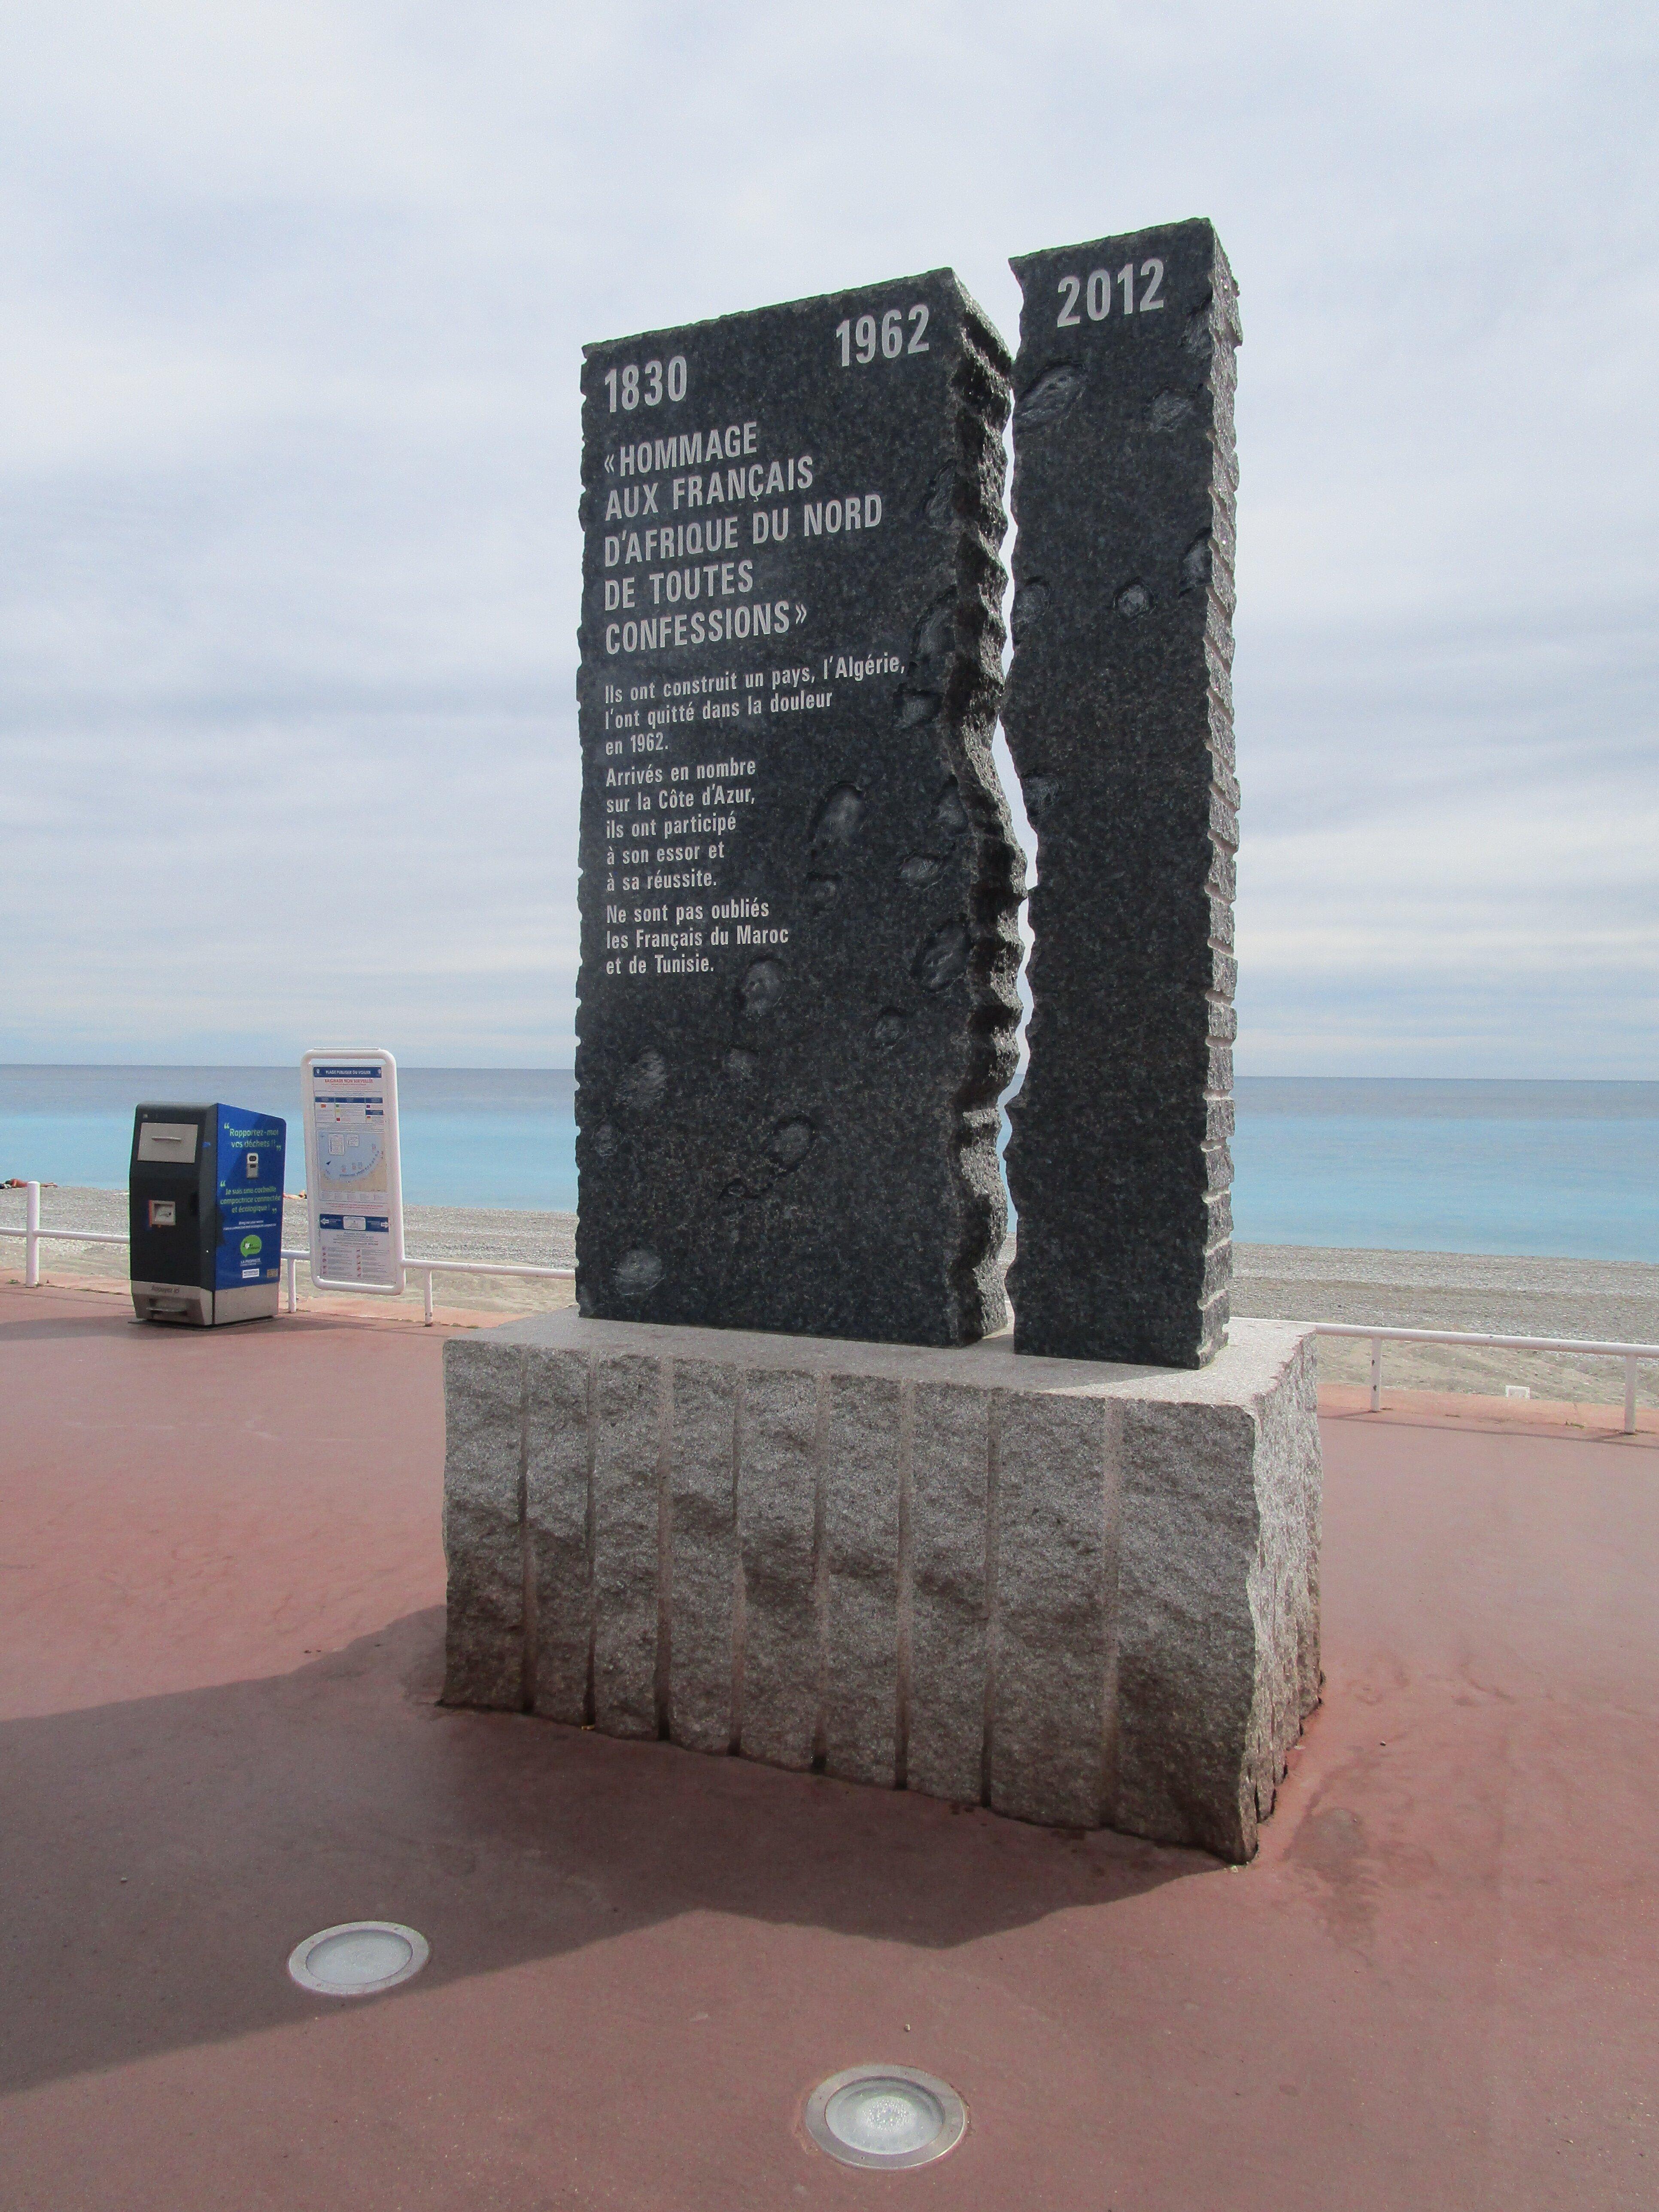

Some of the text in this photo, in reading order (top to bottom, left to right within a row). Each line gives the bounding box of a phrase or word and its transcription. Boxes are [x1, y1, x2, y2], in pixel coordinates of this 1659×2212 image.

[1057, 259, 1164, 327] 2012
[605, 305, 929, 412] 1830 1962
[605, 422, 757, 476] «HOMMAGE
[605, 456, 812, 521] AUX FRANÇAIS
[605, 495, 881, 567] D'AFRIQUE DU NORD
[605, 560, 753, 611] DE TOUTES
[606, 601, 806, 654] CONFESSIONS»
[606, 652, 904, 703] Ils ont construit un pays, l'Algérie,
[606, 690, 832, 729] l'ont quitté dans la douleur
[606, 732, 668, 755] en 1962.
[606, 757, 755, 787] Arrivés en nombre
[607, 784, 754, 812] sur la Côte d'Azur,
[607, 811, 735, 839] ils ont participé
[607, 842, 724, 865] à son essor et
[607, 869, 716, 891] à sa réussite.
[607, 897, 769, 925] Ne sont pas oubliés
[607, 925, 788, 950] les Français du Maroc
[607, 954, 713, 974] et de Tunisie.
[244, 1139, 270, 1148] déchets
